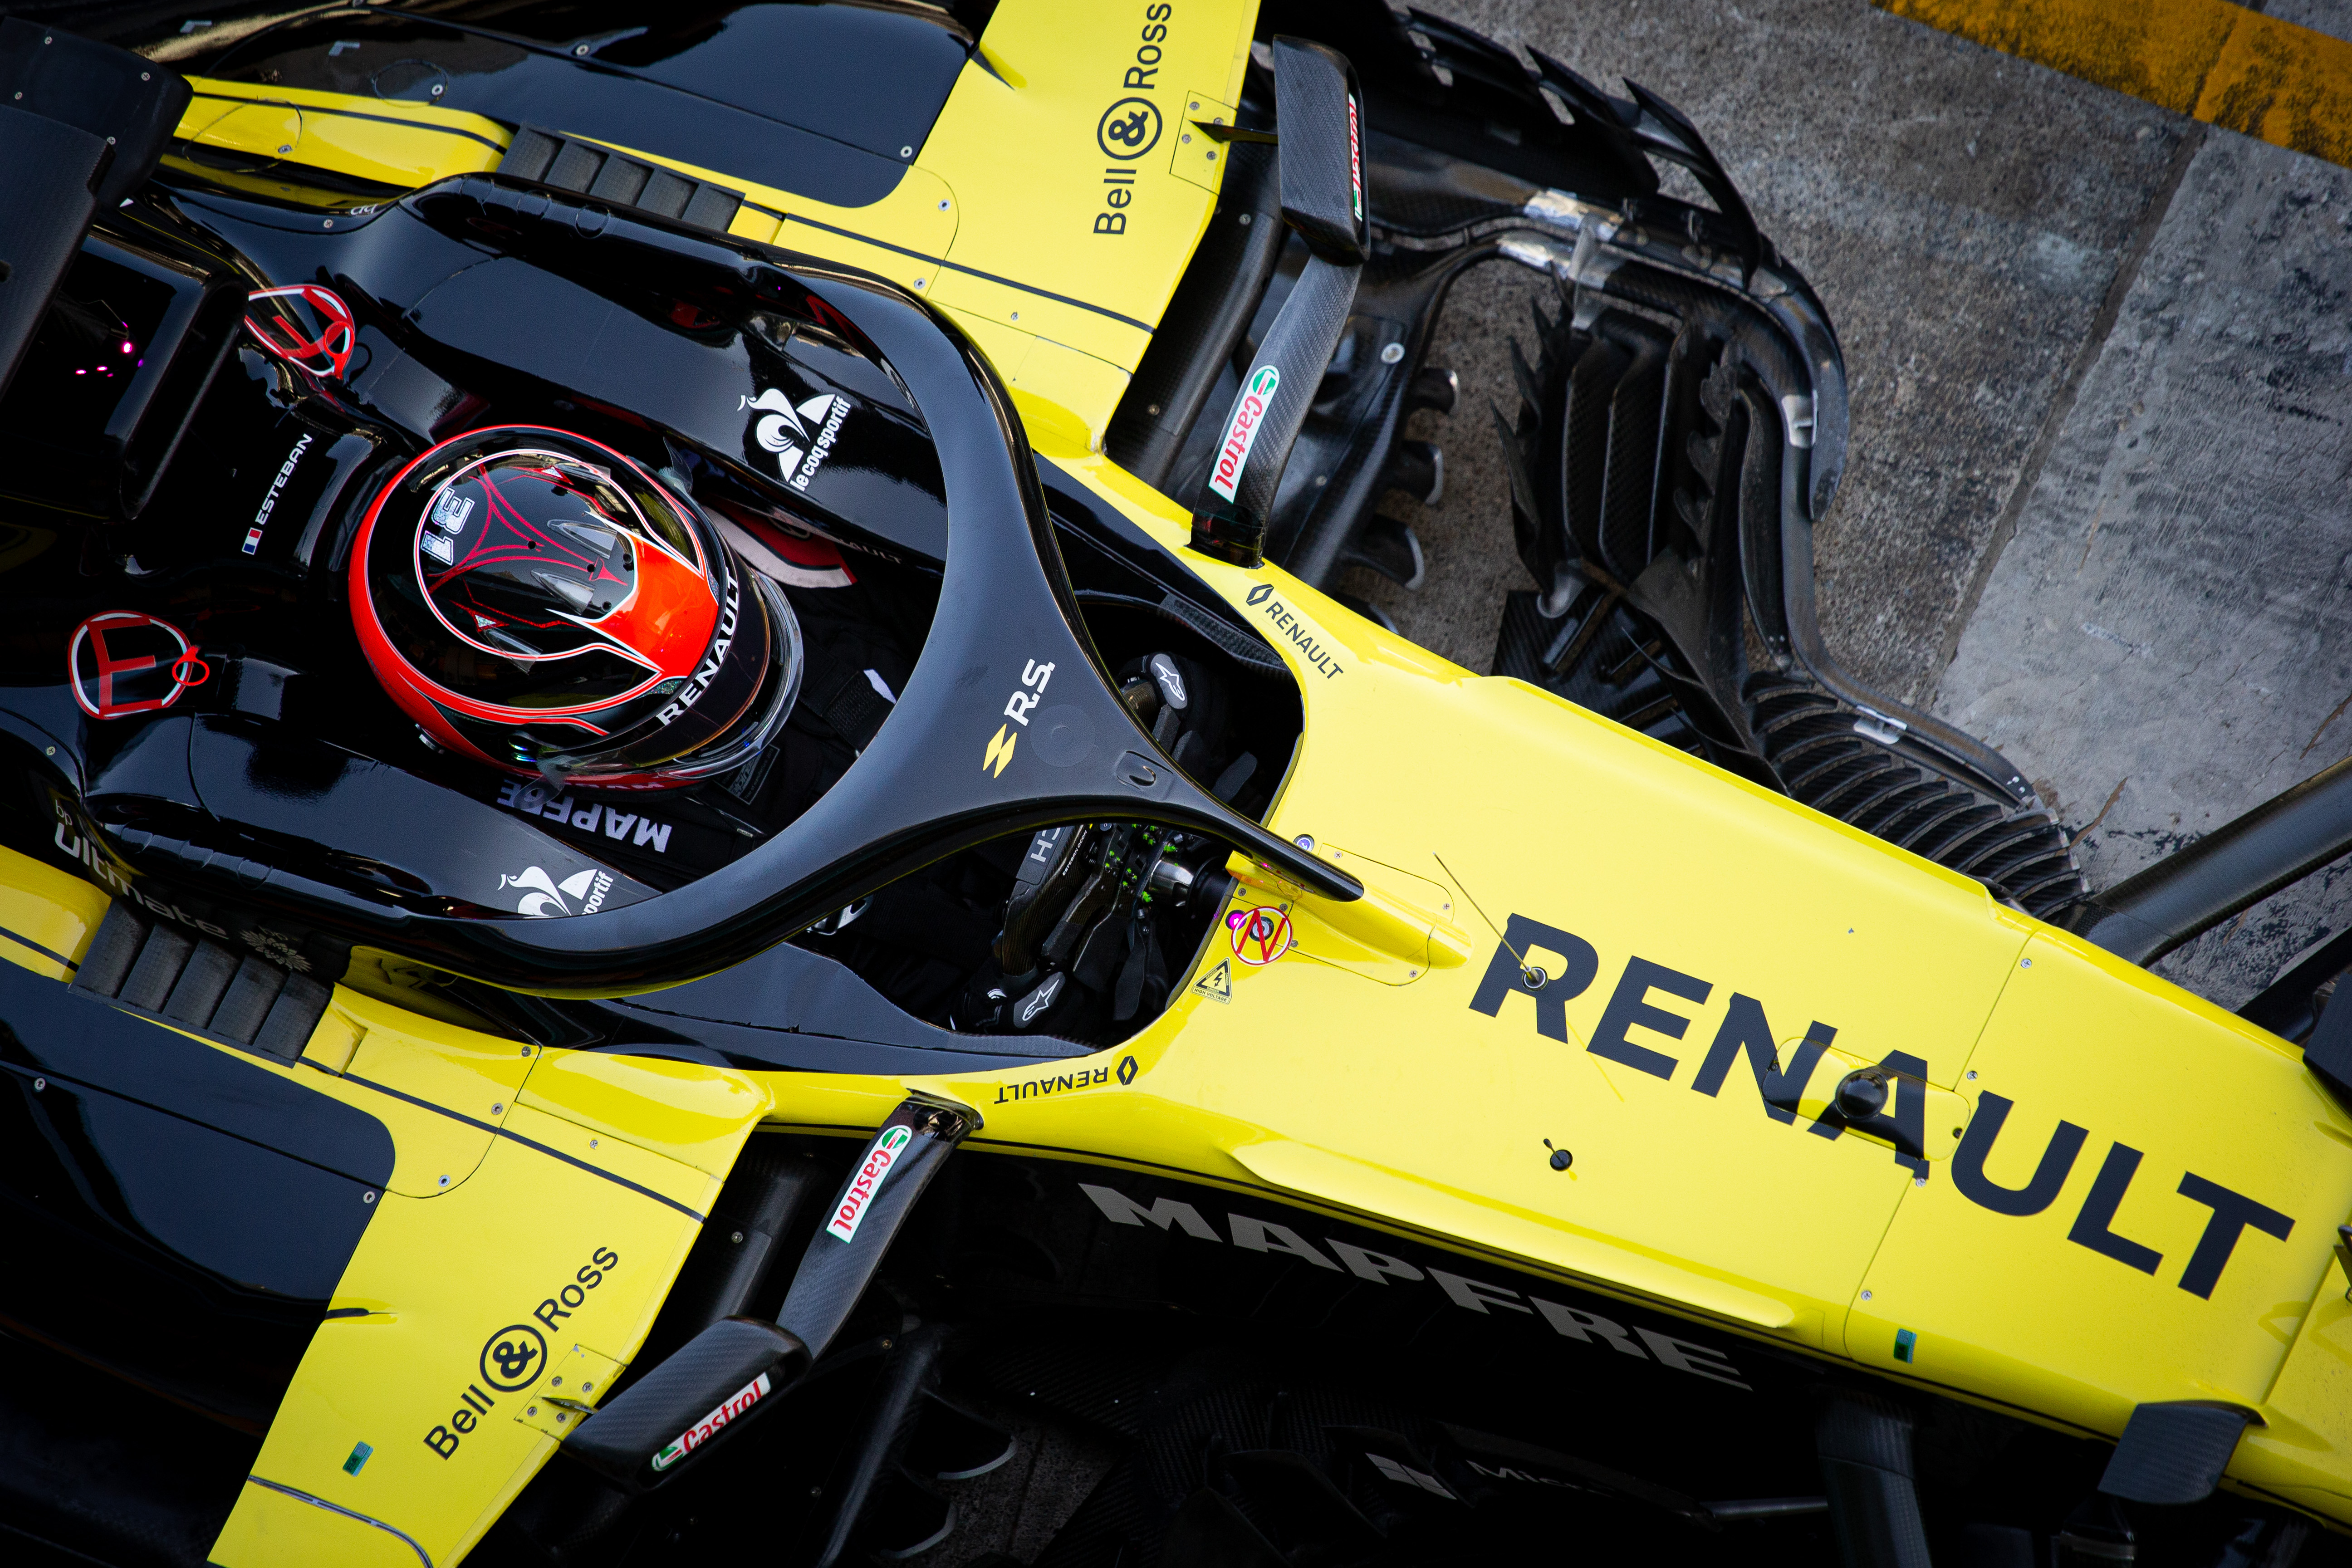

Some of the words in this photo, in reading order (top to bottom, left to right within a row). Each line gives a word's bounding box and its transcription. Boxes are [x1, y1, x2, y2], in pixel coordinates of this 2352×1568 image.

[1093, 168, 1137, 235] Bell
[1122, 3, 1172, 90] Ross
[255, 433, 313, 525] ESTEBAN
[790, 474, 809, 491] le
[802, 445, 828, 476] coq
[817, 396, 851, 449] sportif
[1214, 395, 1264, 490] Castrol
[421, 486, 475, 566] 31
[656, 566, 739, 726] RENAULT
[1265, 601, 1344, 680] RENAULT
[55, 799, 73, 826] bp
[1063, 849, 1078, 876] ESTEBAN
[1078, 830, 1088, 848] OCON
[54, 822, 229, 940] Ultimate
[1207, 992, 1227, 1002] VOLTAGE
[994, 1066, 1108, 1104] RENAULT
[1469, 912, 2296, 1301] RENAULT
[832, 1149, 891, 1233] Castrol
[1078, 1183, 1754, 1392] MAPFRE
[422, 1383, 495, 1461] Bell
[532, 1246, 619, 1333] Ross
[683, 1379, 762, 1454] Castrol
